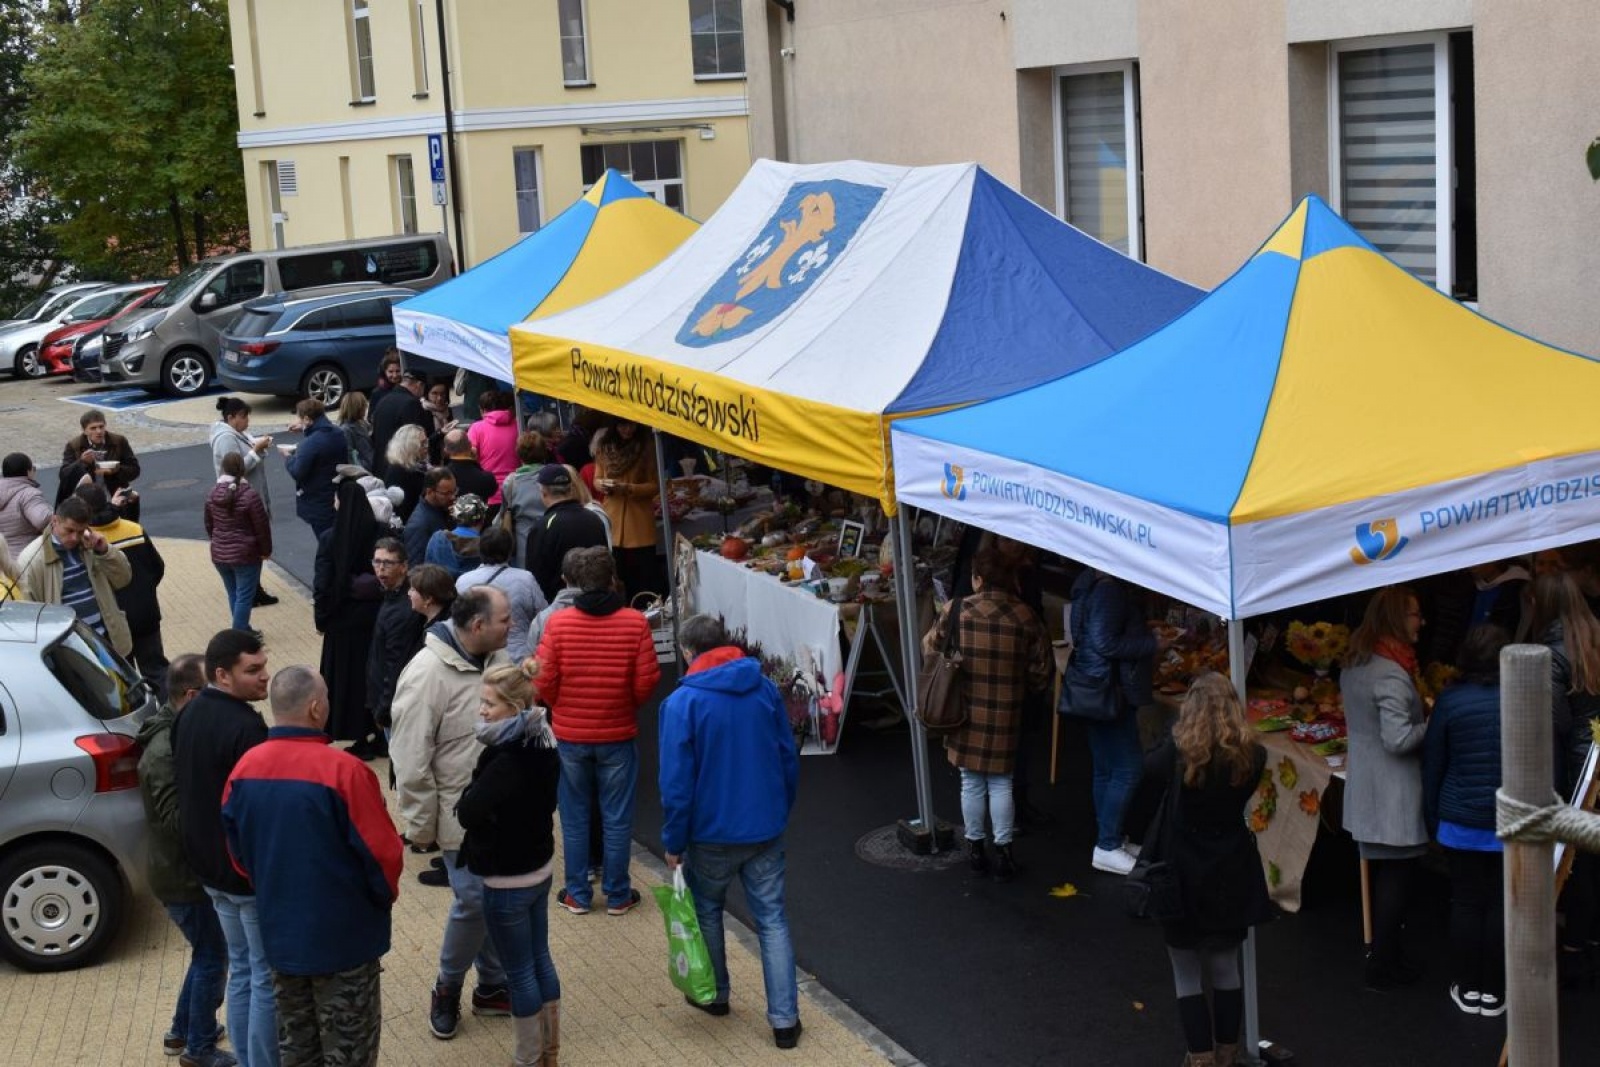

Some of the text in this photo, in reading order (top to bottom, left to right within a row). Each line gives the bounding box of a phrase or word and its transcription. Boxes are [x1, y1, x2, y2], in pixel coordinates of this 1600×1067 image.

[431, 138, 440, 168] P
[571, 347, 760, 442] Powiat Wodzisławski
[972, 471, 1157, 548] POWIATWODZISLAWSKI.PL
